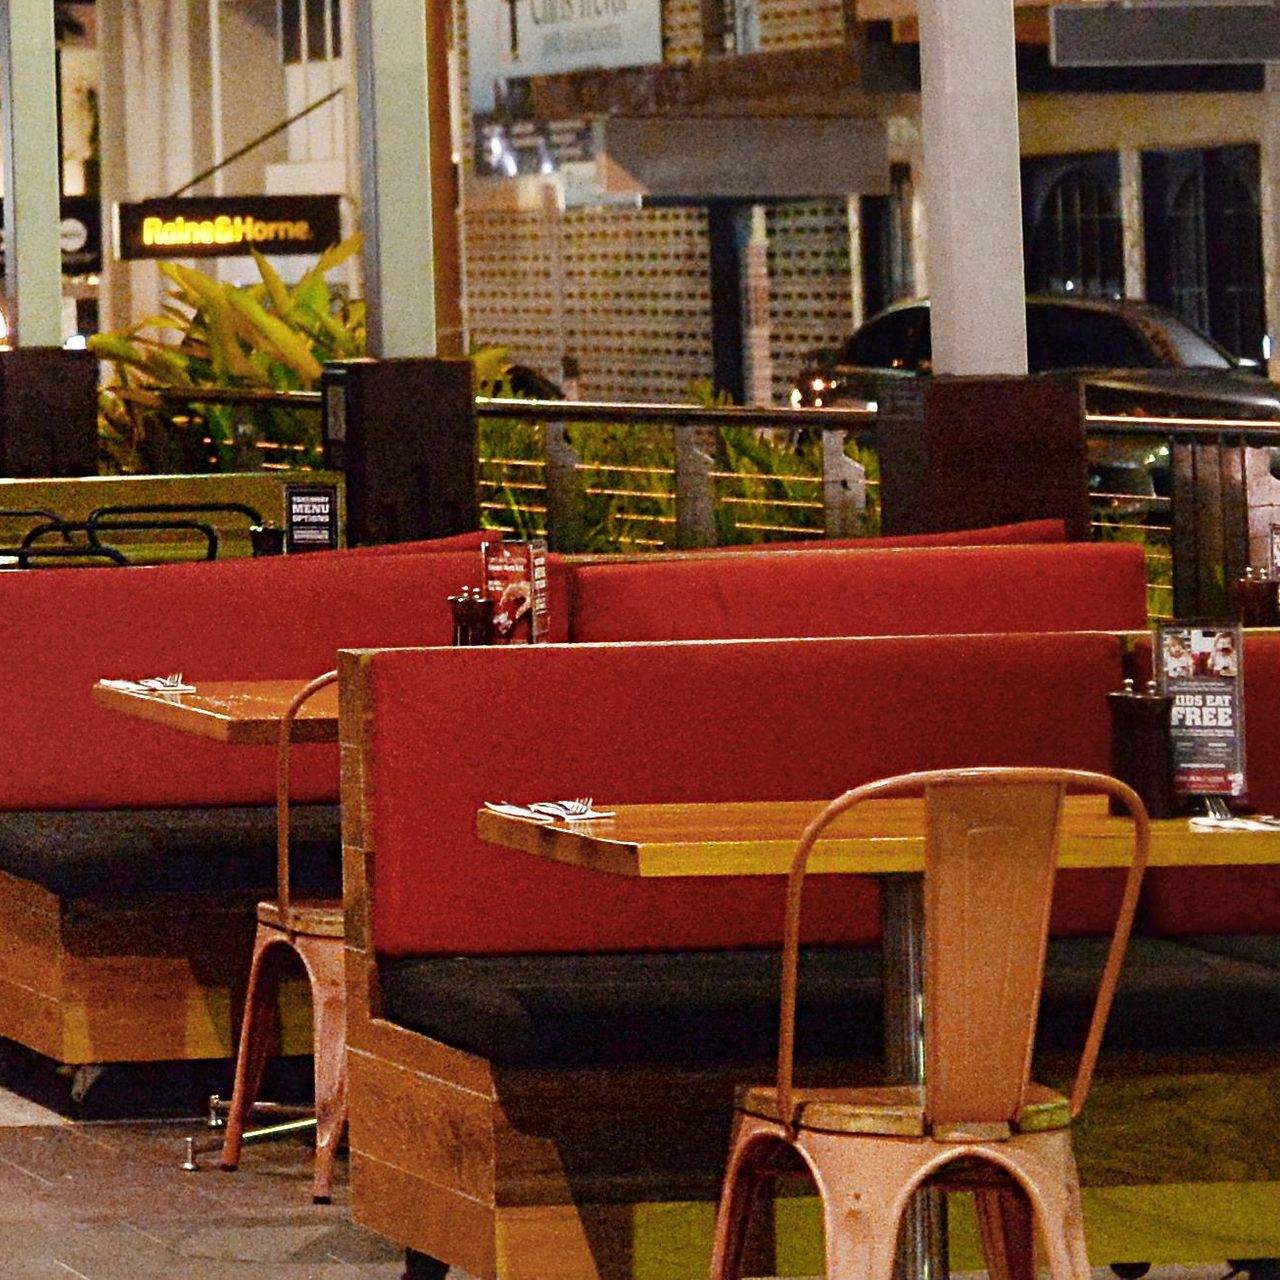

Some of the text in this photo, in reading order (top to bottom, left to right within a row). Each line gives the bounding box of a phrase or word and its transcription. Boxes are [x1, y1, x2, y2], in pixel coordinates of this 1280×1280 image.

[292, 504, 329, 514] MENU
[1206, 695, 1232, 706] EAT
[1171, 707, 1233, 726] FREE
